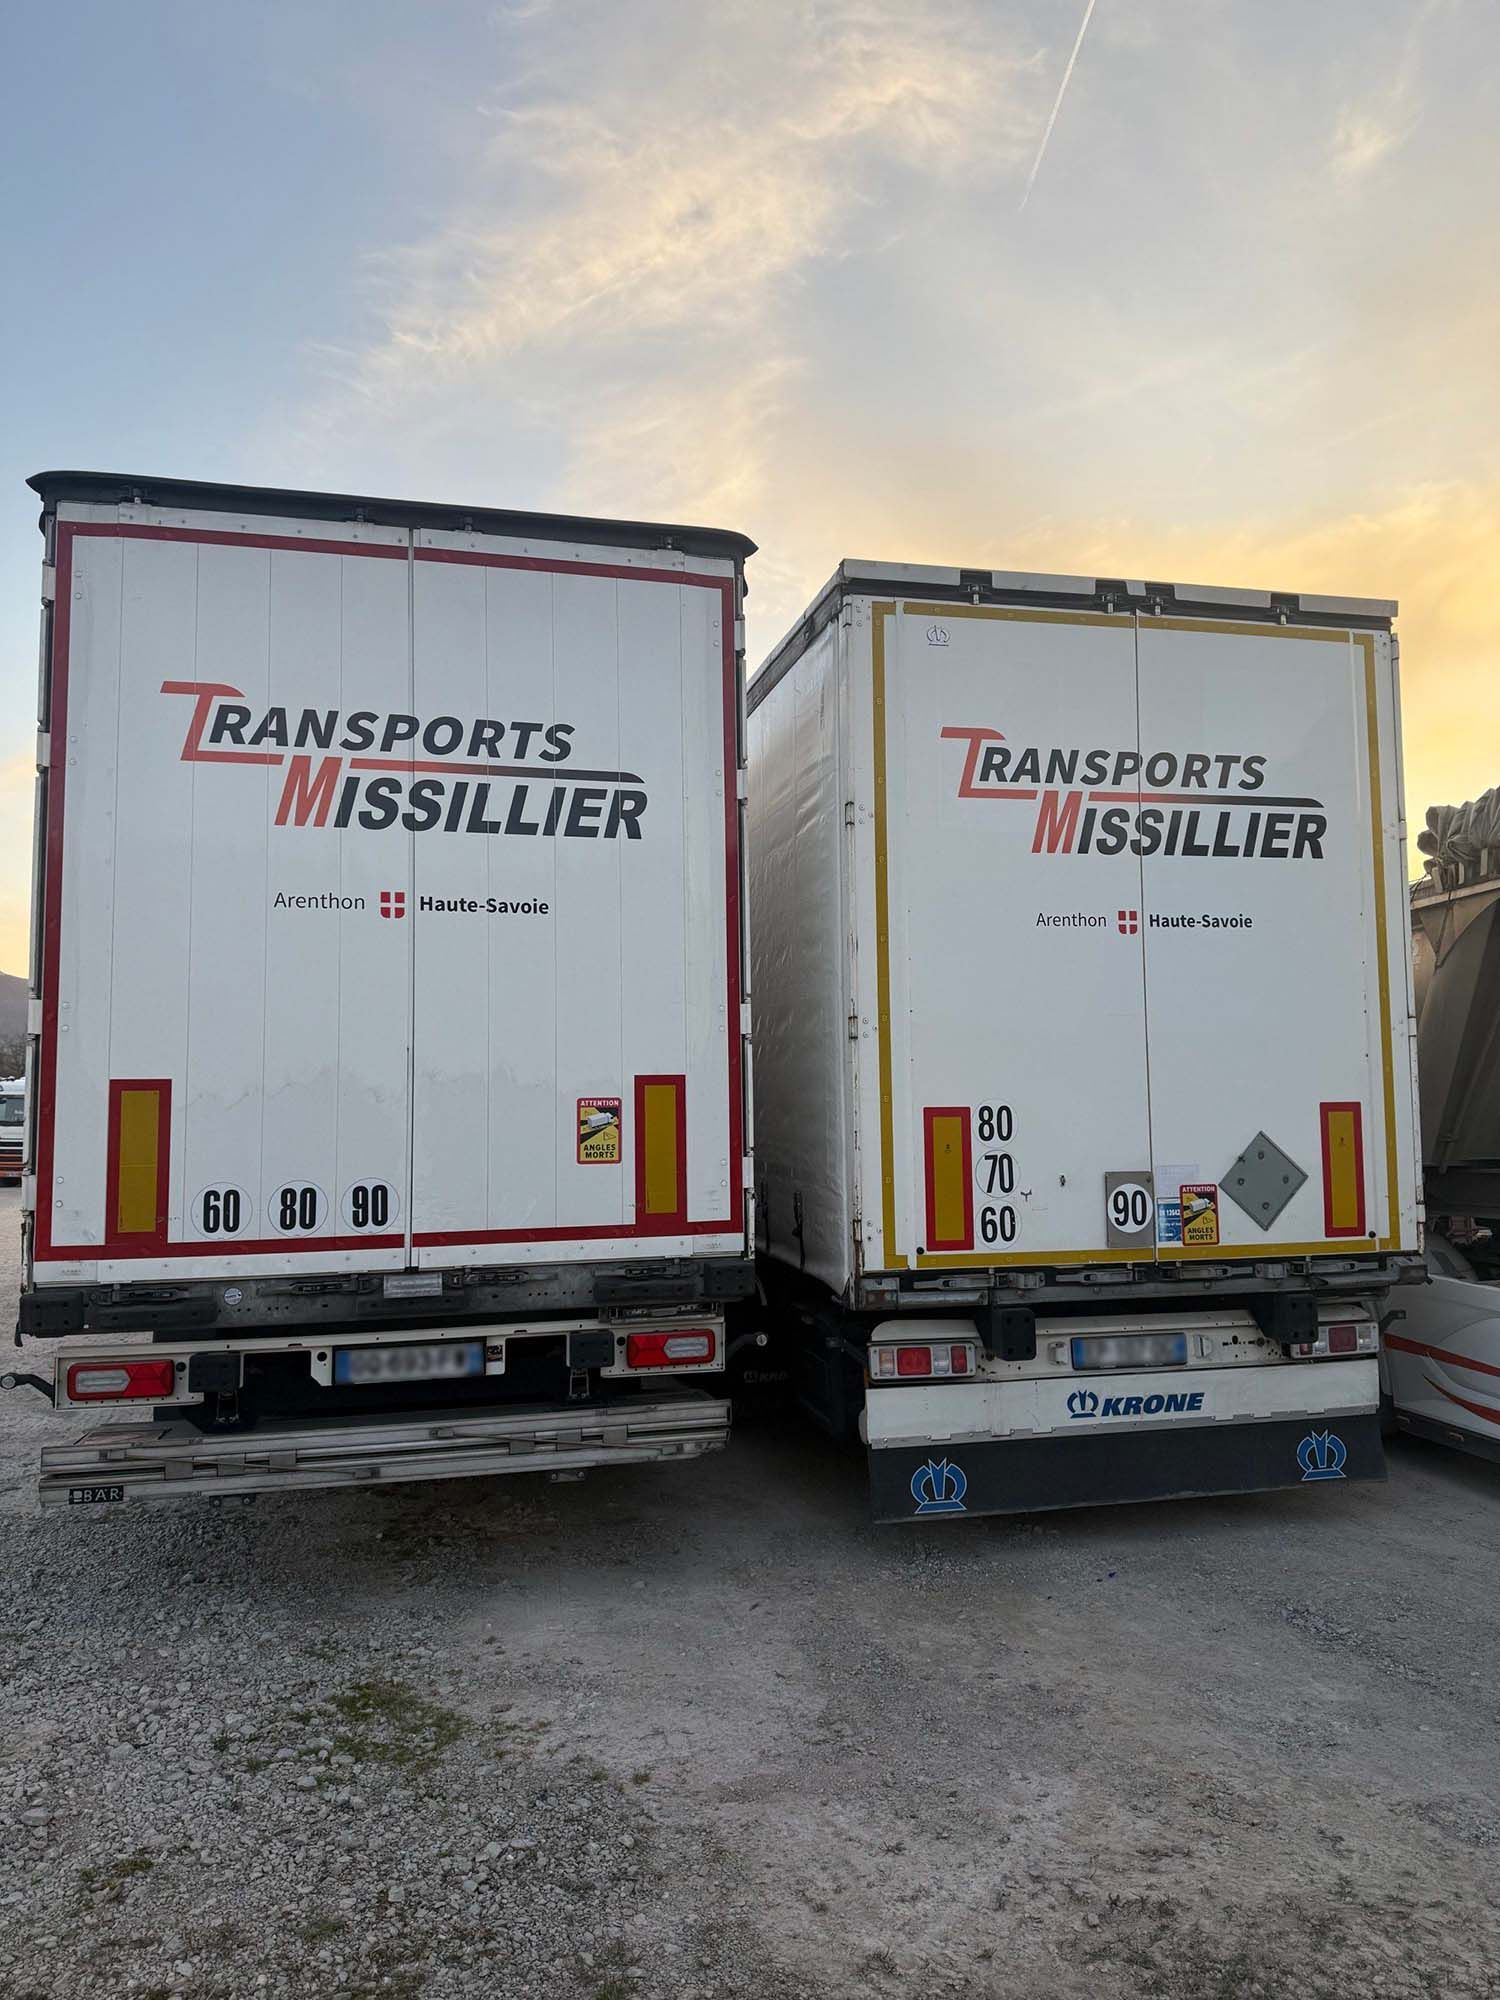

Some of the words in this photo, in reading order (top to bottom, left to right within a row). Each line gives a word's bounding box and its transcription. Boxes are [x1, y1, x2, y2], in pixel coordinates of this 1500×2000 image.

[160, 680, 575, 765] TRANSPORTS
[940, 726, 1267, 800] TRANSPORTS
[274, 754, 648, 840] MISSILLIER
[1031, 790, 1328, 860] MISSILLIER
[273, 891, 365, 911] Arenthon
[419, 895, 550, 915] Haute-Savoie
[1036, 912, 1107, 928] Arenthon
[1149, 913, 1253, 929] Haute-Savoie
[978, 1105, 1013, 1141] 80
[583, 1143, 616, 1152] ANGLES
[585, 1151, 615, 1159] MORTS
[984, 1153, 1015, 1194] 70
[203, 1189, 241, 1233] 60
[279, 1187, 317, 1230] 80
[352, 1184, 389, 1228] 90
[981, 1205, 1016, 1243] 60
[1113, 1190, 1148, 1226] 90
[1101, 1391, 1206, 1417] KRONE
[83, 1488, 120, 1502] BÄR
